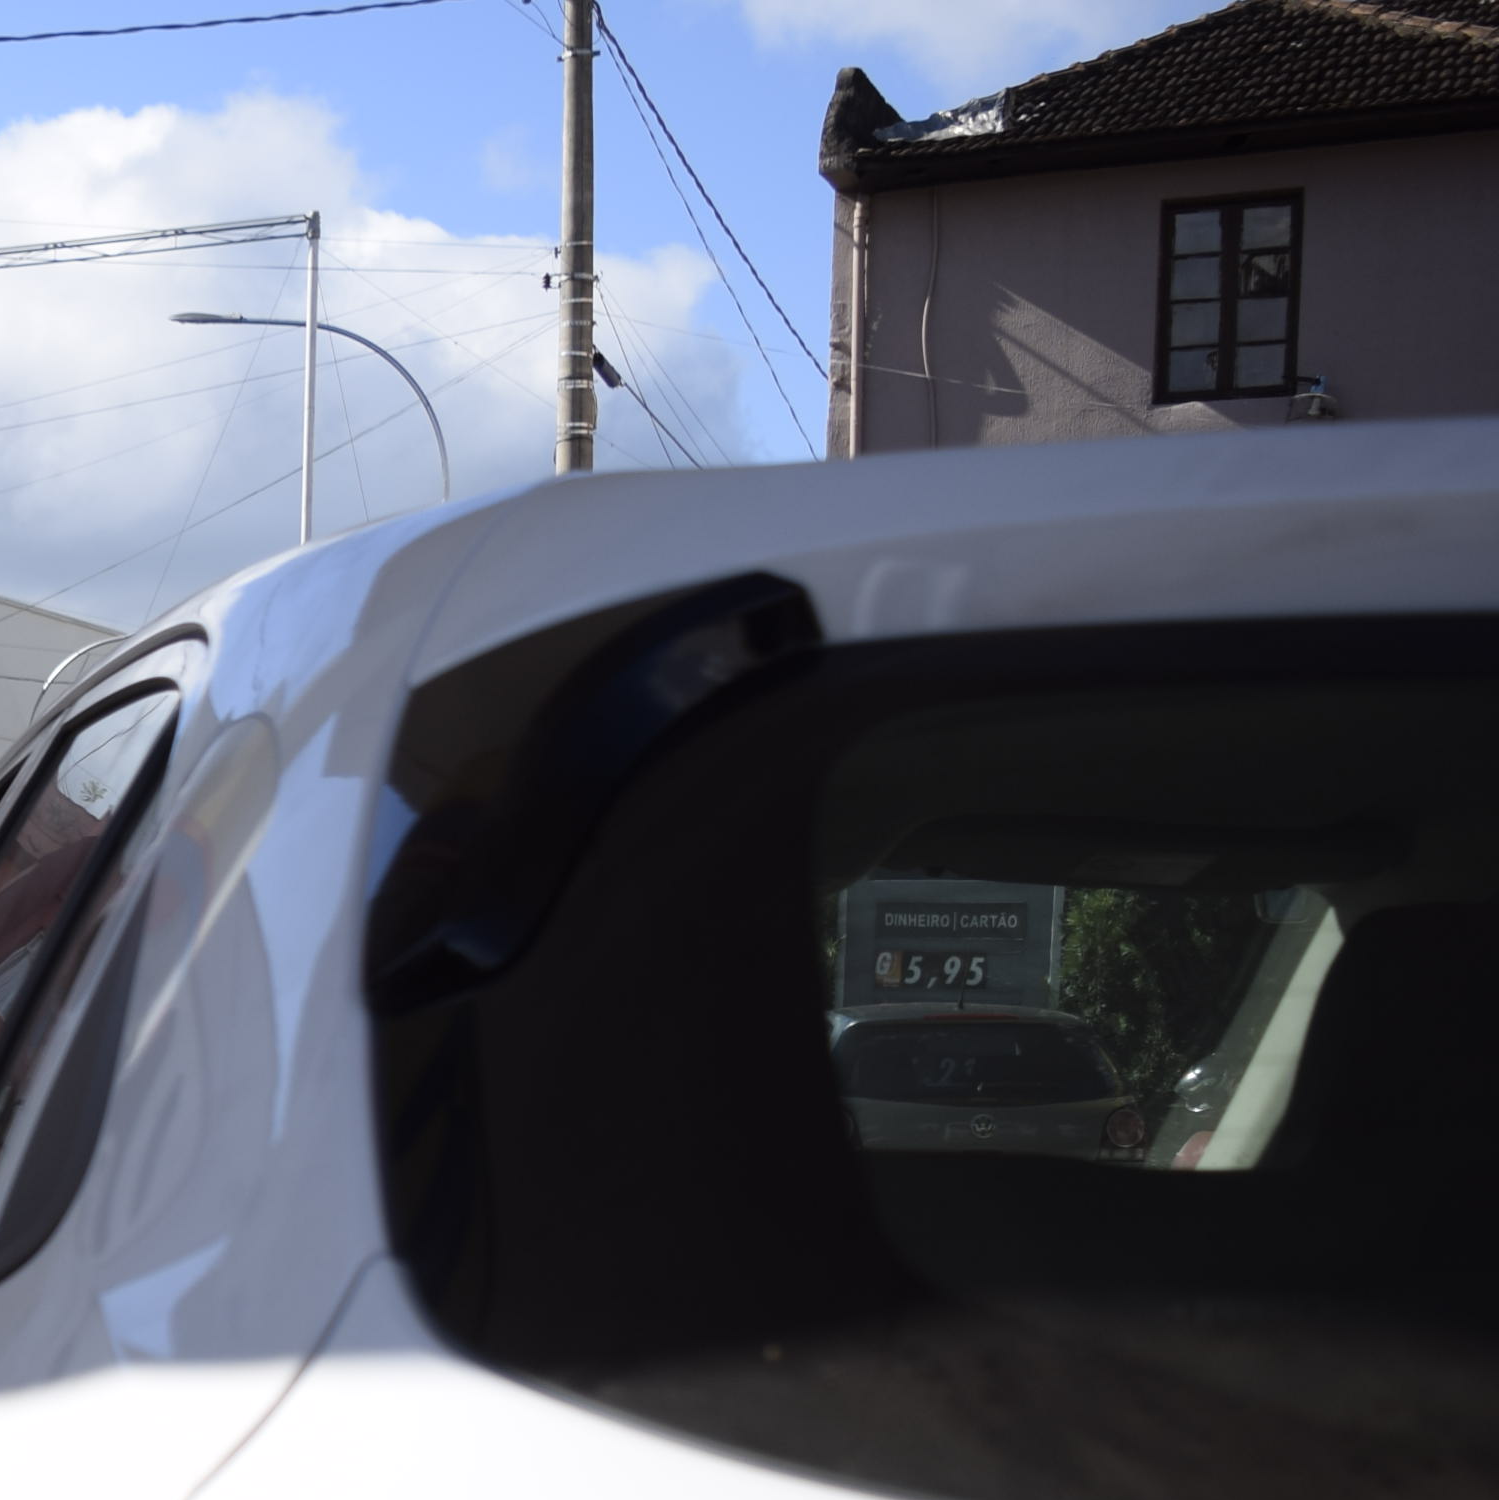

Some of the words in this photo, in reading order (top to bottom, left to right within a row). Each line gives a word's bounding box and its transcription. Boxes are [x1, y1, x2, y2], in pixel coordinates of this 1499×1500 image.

[885, 912, 950, 928] DINHEIRO
[960, 912, 1018, 928] CARTÃO
[904, 956, 985, 989] 5,95
